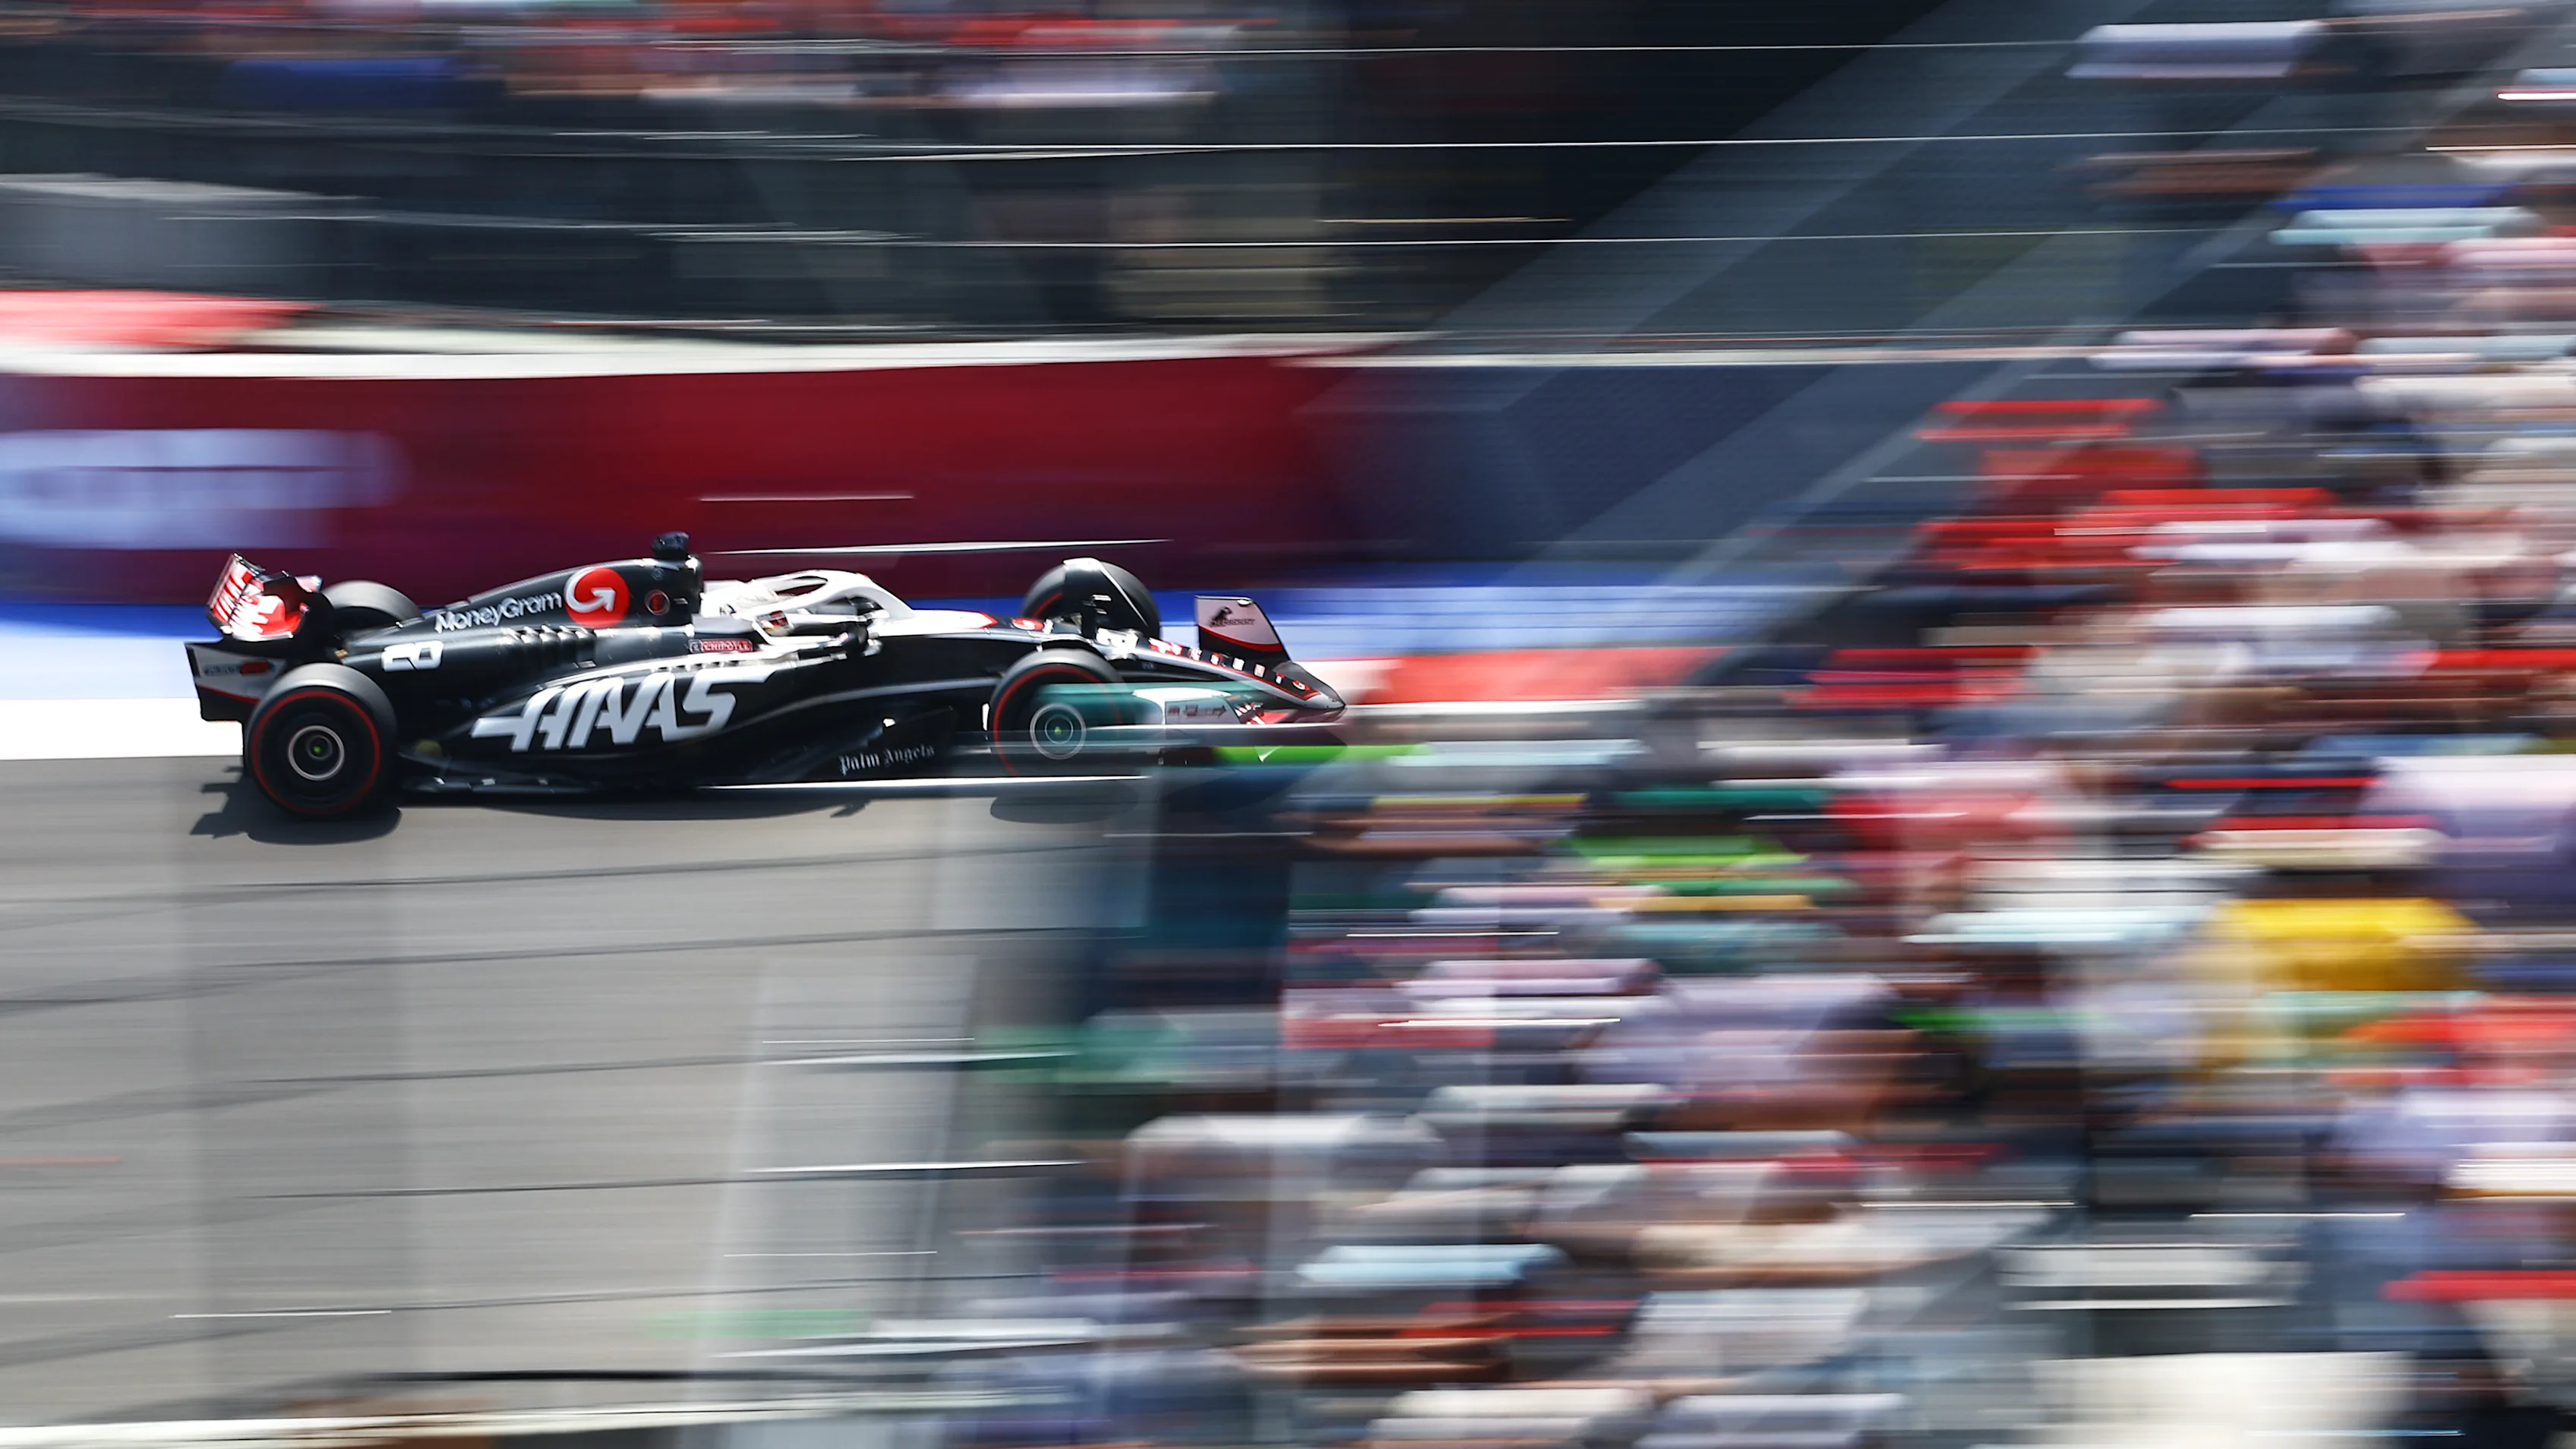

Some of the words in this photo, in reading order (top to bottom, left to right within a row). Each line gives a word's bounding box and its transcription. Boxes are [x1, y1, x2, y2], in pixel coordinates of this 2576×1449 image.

[434, 592, 562, 633] MoneyGram
[381, 640, 444, 671] 20
[469, 666, 775, 753] HAAS
[838, 753, 880, 775] Palm
[884, 743, 935, 767] Angels
